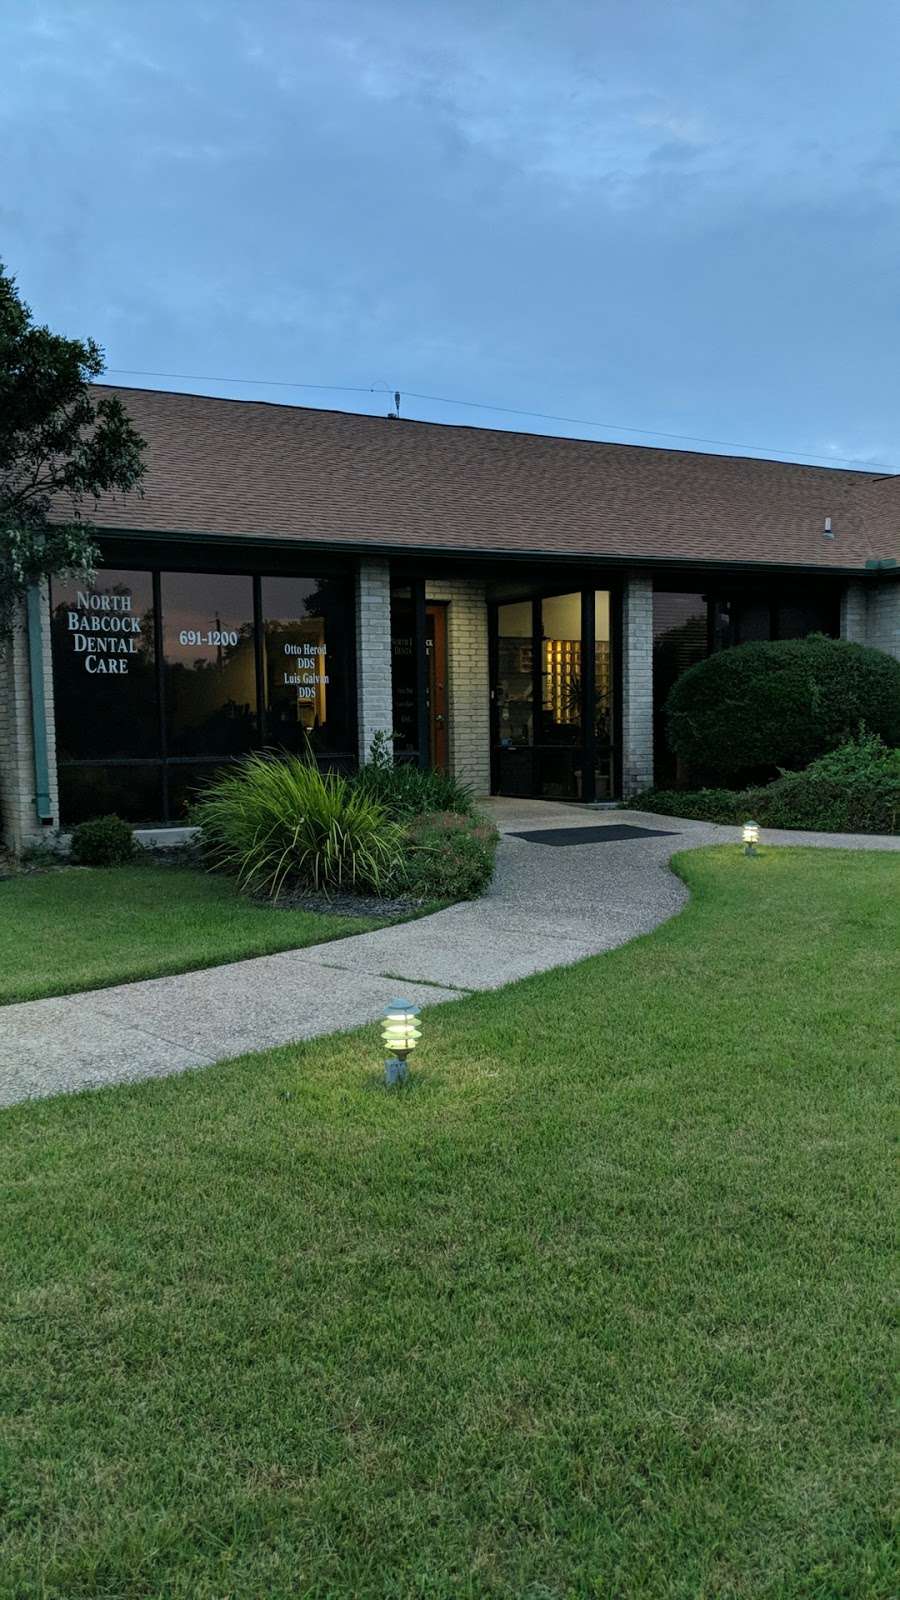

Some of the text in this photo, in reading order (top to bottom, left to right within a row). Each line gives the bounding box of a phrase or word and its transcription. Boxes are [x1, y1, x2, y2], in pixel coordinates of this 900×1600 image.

[76, 591, 132, 610] NORTH
[67, 611, 142, 633] BABCOCK
[73, 633, 138, 653] DENTAL
[179, 630, 238, 646] 691-1200
[284, 643, 327, 655] Otto Herod
[85, 655, 128, 673] CARE
[297, 658, 315, 669] DDS
[284, 672, 301, 684] Luis
[299, 687, 316, 698] DDS
